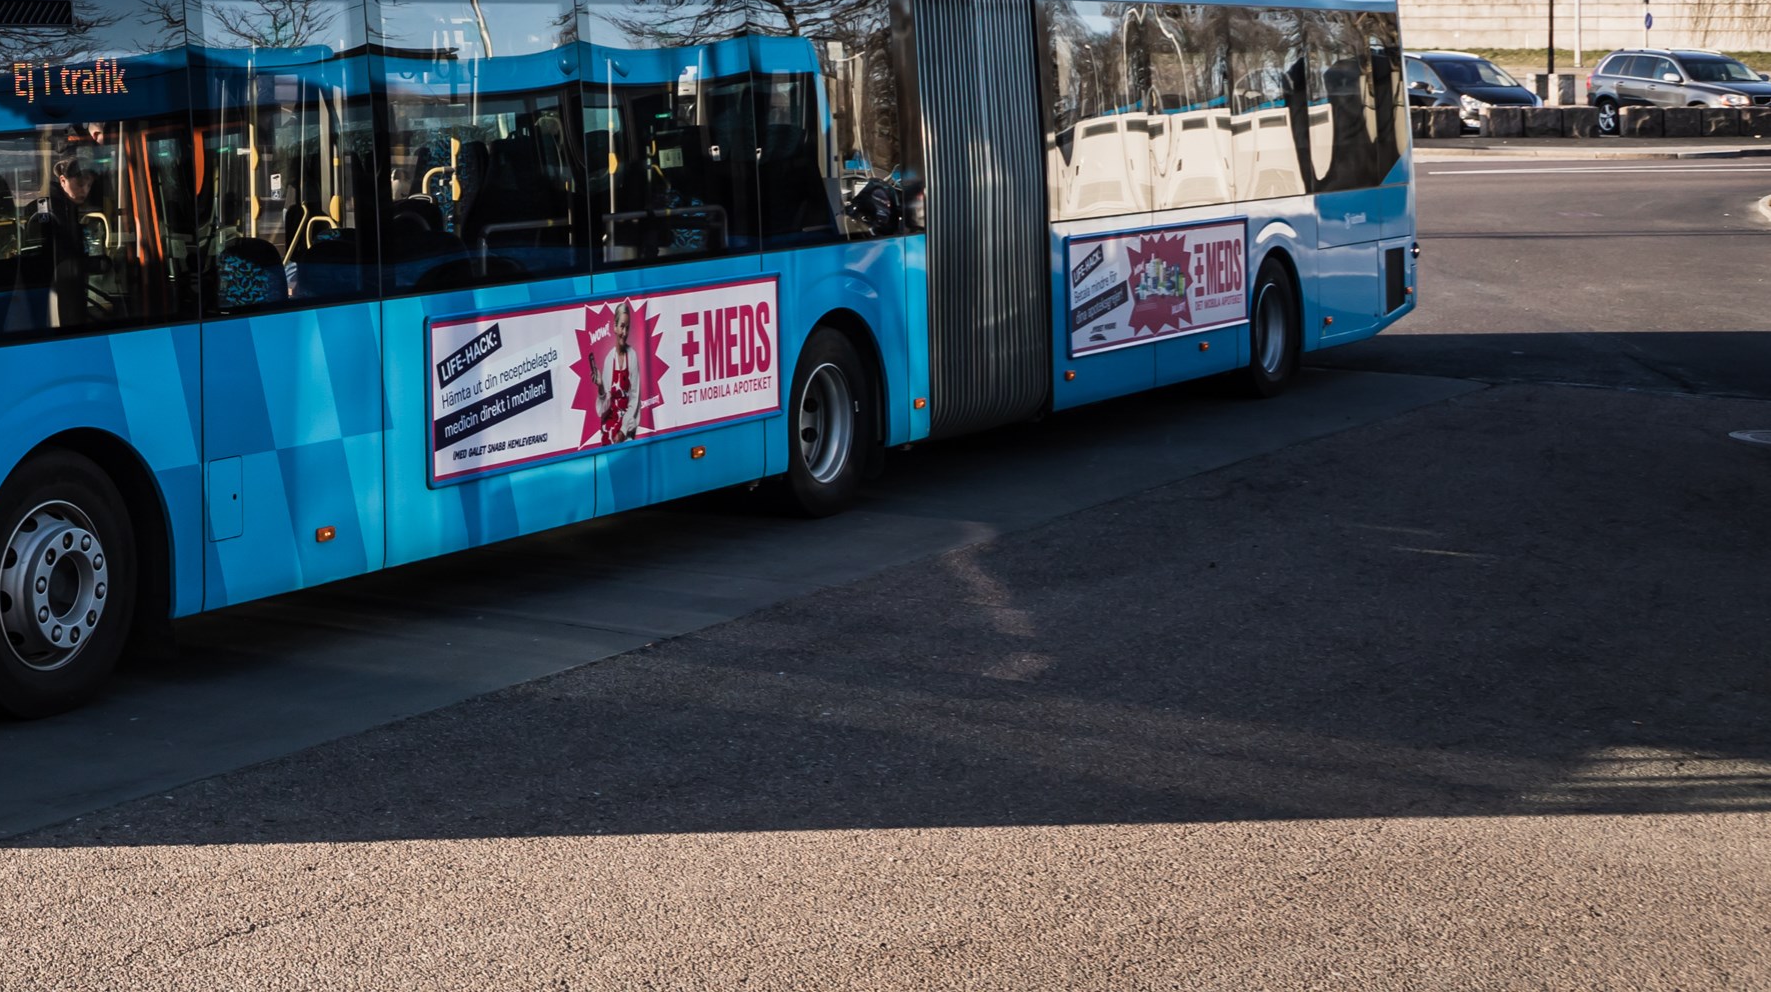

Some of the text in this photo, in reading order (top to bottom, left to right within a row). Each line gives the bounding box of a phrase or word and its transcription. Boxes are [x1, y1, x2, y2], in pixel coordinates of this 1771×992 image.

[13, 56, 129, 104] Ej i trafik
[1206, 238, 1242, 296] MEDS
[441, 332, 497, 381] LIFE-HACK:
[703, 301, 772, 382] MEDS
[441, 347, 558, 409] Hämta ut din receptbelagda
[682, 376, 772, 405] DET MOBILA APOTEKET
[444, 379, 546, 439] medicin direkt i mobilen!
[453, 446, 468, 461] (MED
[469, 443, 487, 457] GALET
[487, 439, 506, 454] SNABB
